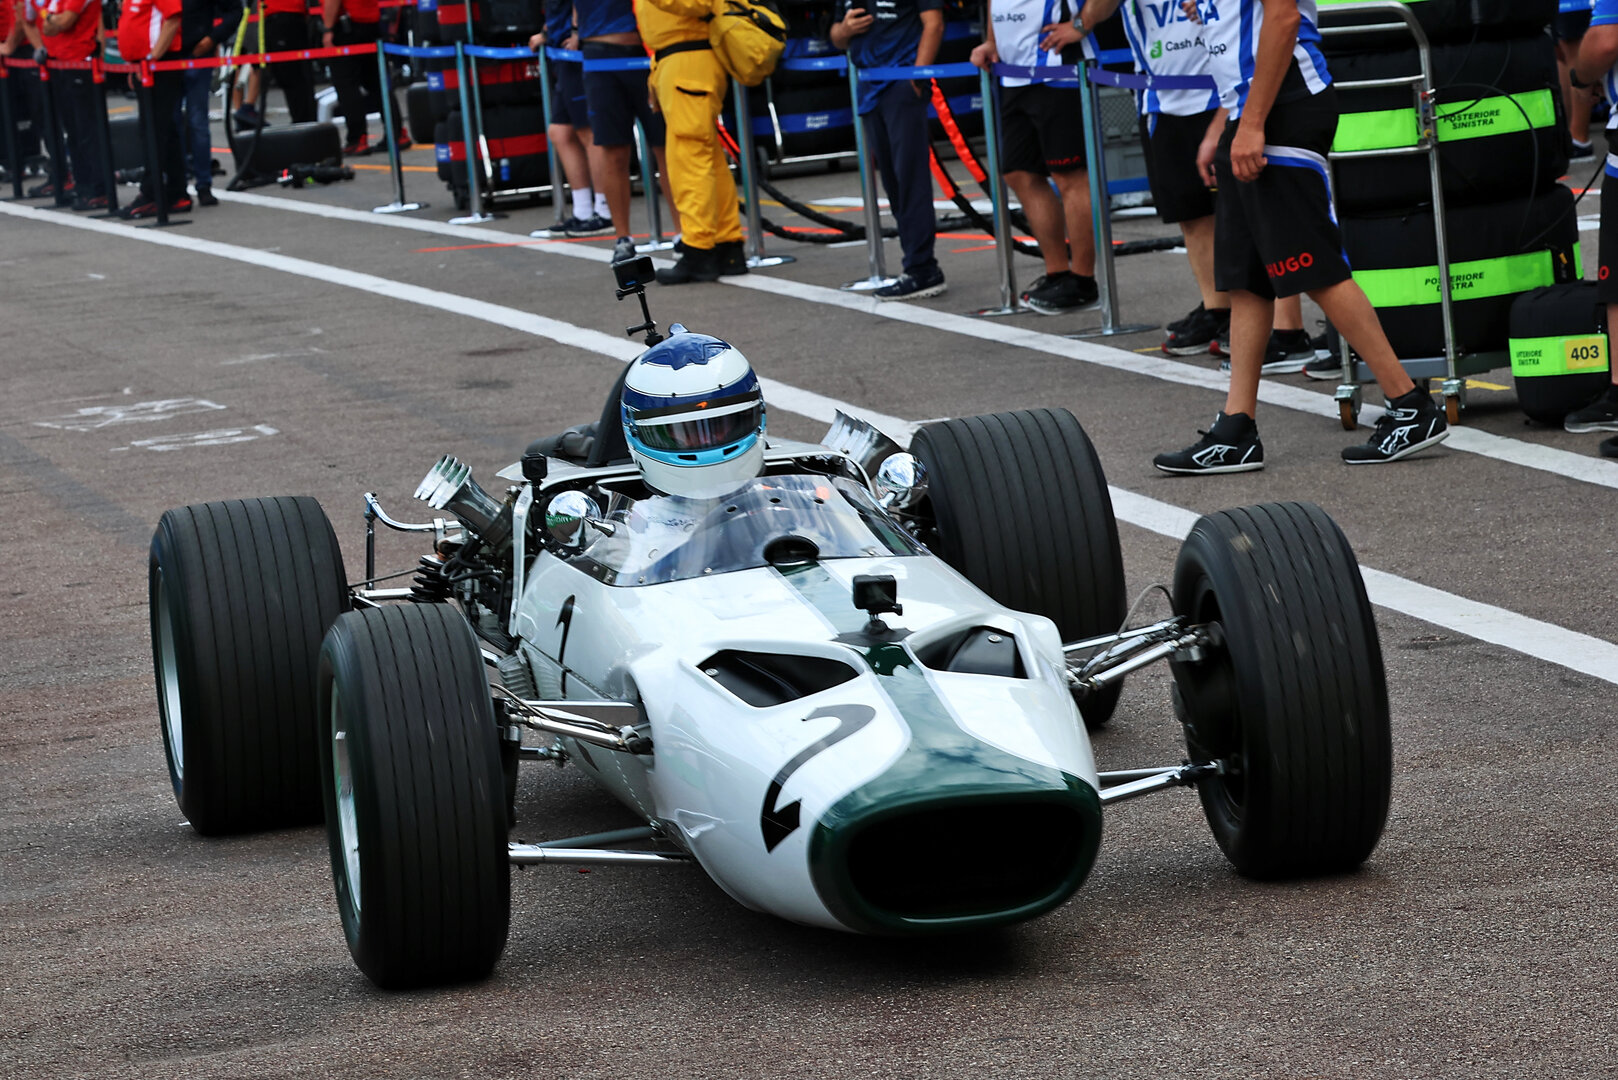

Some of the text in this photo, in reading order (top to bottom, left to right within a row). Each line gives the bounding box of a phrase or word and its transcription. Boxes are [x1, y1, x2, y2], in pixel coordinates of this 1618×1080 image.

[1165, 38, 1192, 51] Cash
[1443, 109, 1500, 123] POSTERIORE
[1452, 118, 1494, 130] SINISTRA
[1265, 252, 1313, 278] HUGO
[1425, 272, 1483, 285] POERIORE
[1571, 345, 1599, 361] 403
[759, 703, 877, 854] 2
